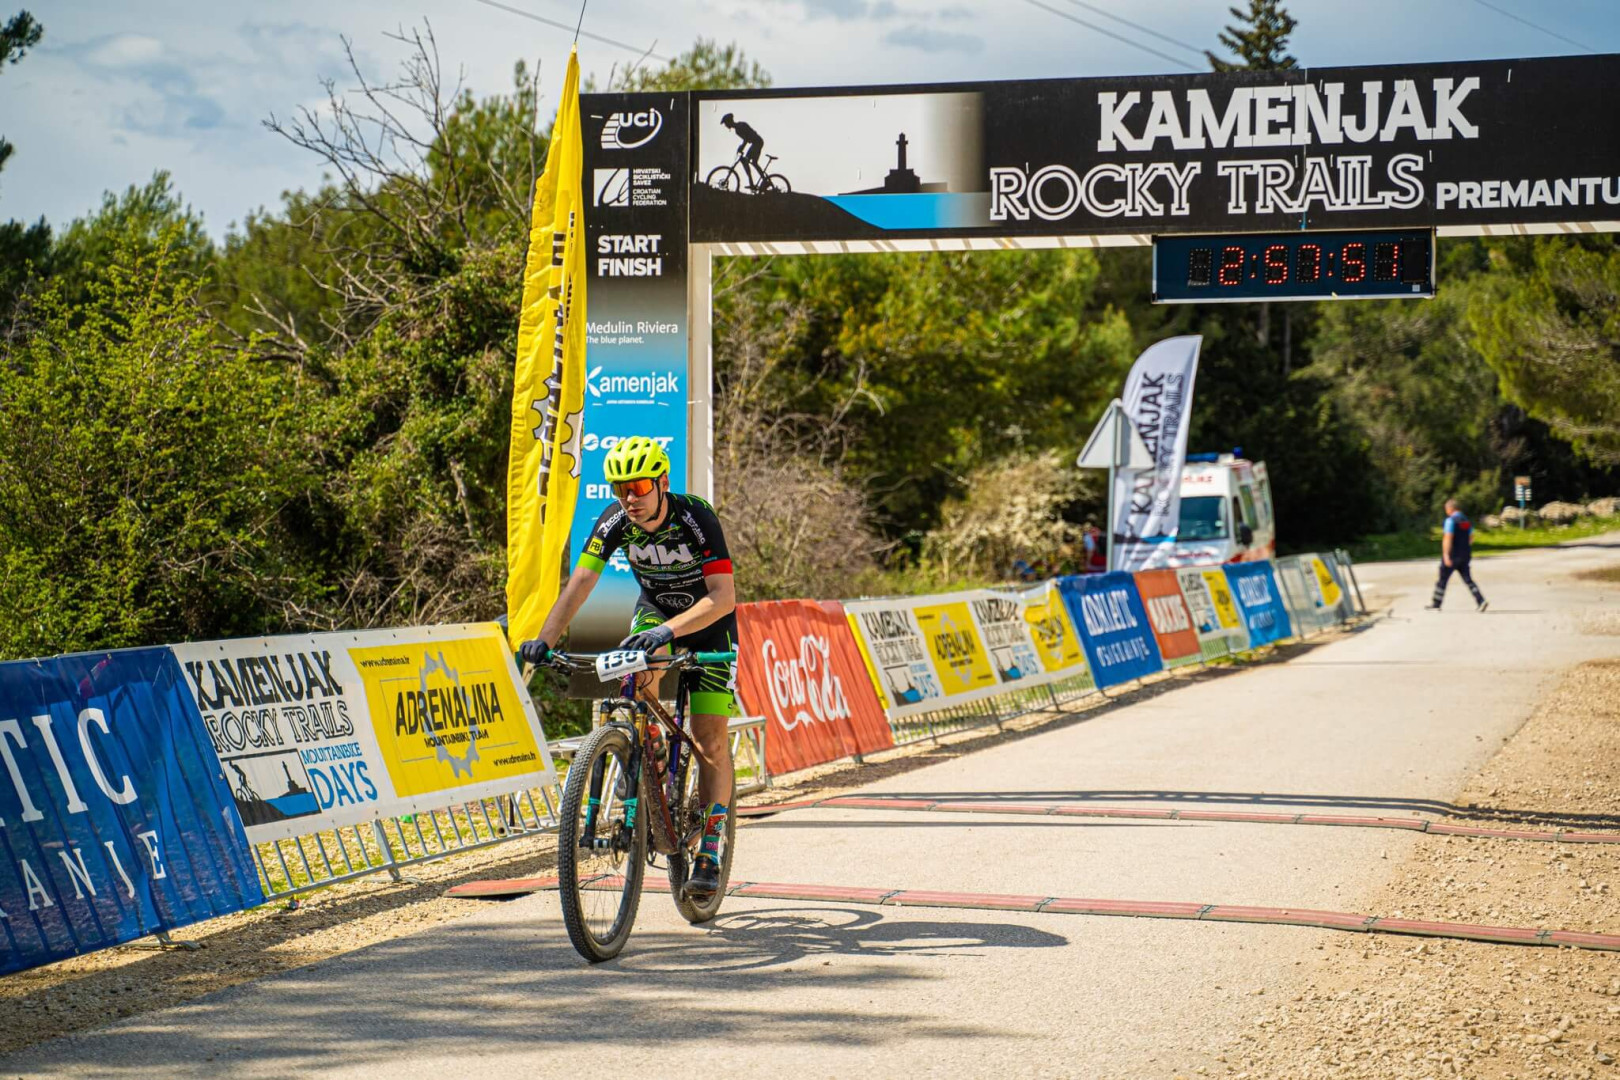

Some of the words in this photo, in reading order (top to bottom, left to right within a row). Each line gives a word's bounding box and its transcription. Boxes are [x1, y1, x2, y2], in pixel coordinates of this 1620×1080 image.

[1098, 77, 1480, 152] KAMENJAK
[990, 161, 1200, 221] ROCKY
[1218, 154, 1424, 216] TRAILS
[597, 235, 661, 253] START
[598, 258, 662, 276] FINISH
[585, 321, 633, 334] Medulin
[637, 321, 678, 334] Riviera
[585, 336, 599, 344] The
[600, 336, 616, 344] blue
[618, 336, 644, 346] planet.
[628, 543, 694, 565] MW
[185, 650, 343, 711] KAMENJAK
[203, 707, 283, 754] ROCKY
[283, 700, 354, 745] TRAILS
[395, 682, 504, 737] ADRENALINA
[0, 707, 138, 827] TIC
[306, 760, 379, 810] DAYS
[0, 830, 166, 918] ANJE
